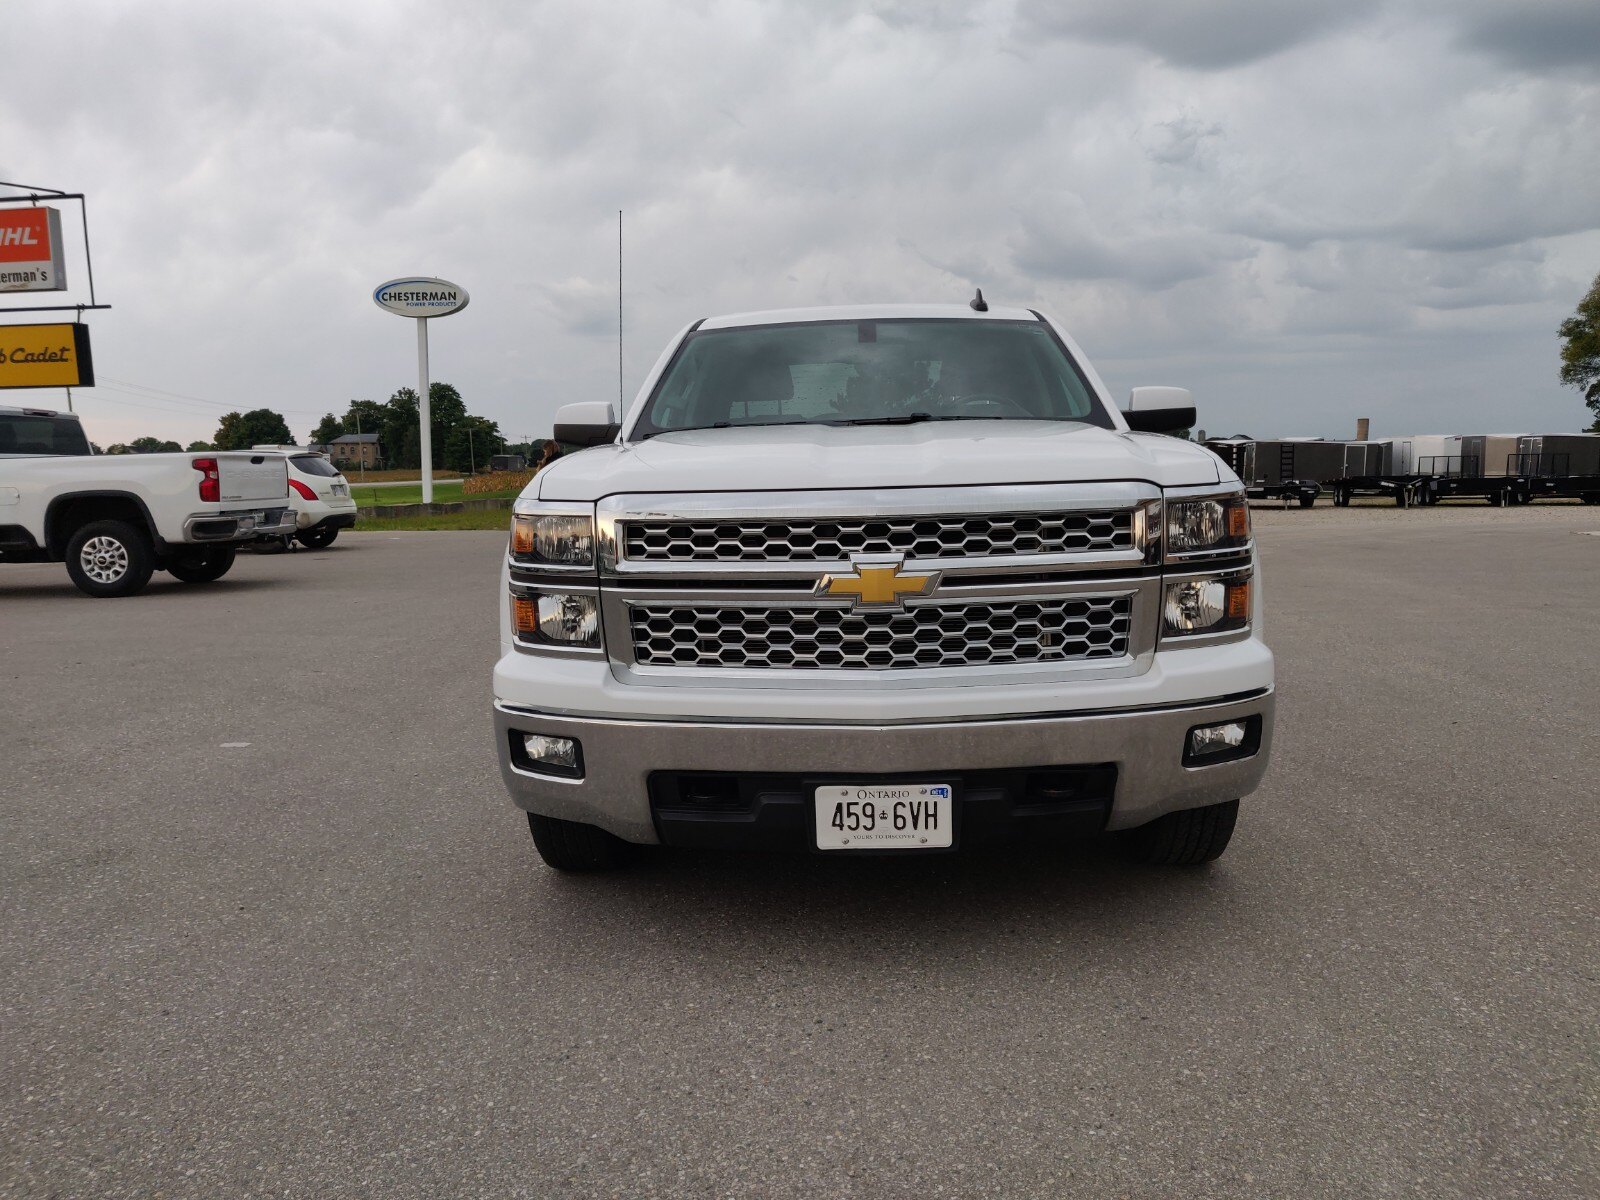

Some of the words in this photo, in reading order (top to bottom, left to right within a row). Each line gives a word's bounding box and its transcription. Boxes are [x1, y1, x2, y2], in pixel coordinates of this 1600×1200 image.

[0, 267, 48, 283] erman's
[381, 291, 457, 302] CHESTERMAN
[10, 346, 71, 363] Cadet
[857, 789, 910, 800] ONTARIO
[831, 801, 876, 831] 459
[893, 800, 938, 831] 6VH
